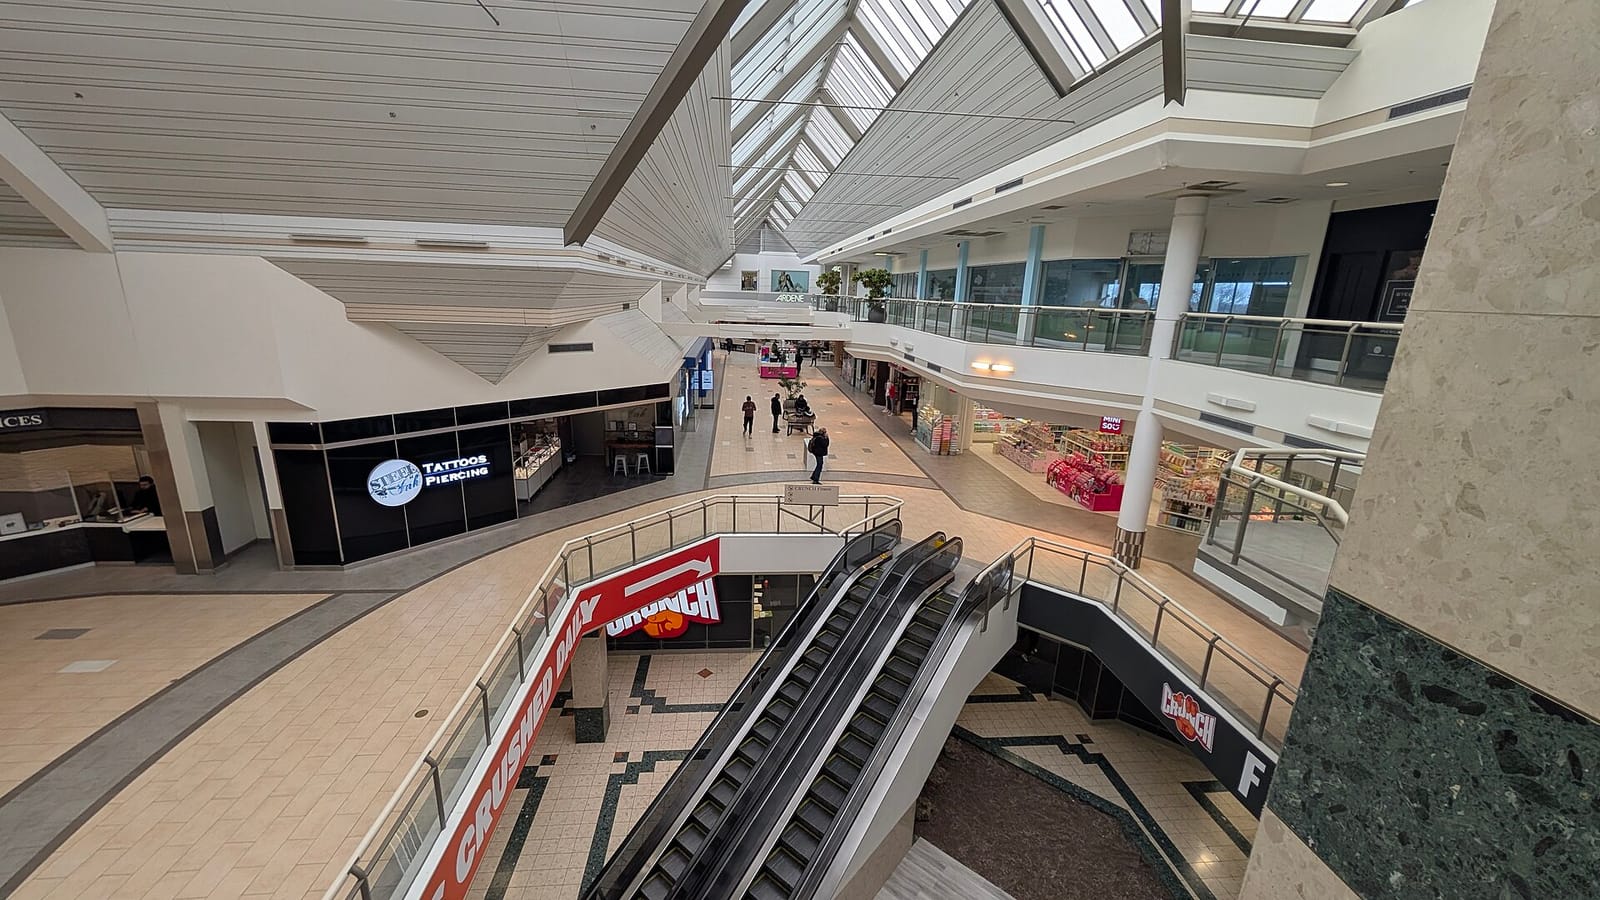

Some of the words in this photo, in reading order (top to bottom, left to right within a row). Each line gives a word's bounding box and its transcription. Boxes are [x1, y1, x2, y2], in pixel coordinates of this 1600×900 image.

[776, 294, 804, 302] ARDENE
[370, 464, 418, 490] STEEL
[422, 455, 487, 474] TATTOOS
[425, 467, 489, 486] PIERCING
[1161, 683, 1216, 752] CRUNCH
[455, 667, 553, 884] CRUSHED
[556, 594, 602, 679] DAILY
[1238, 750, 1266, 798] F
